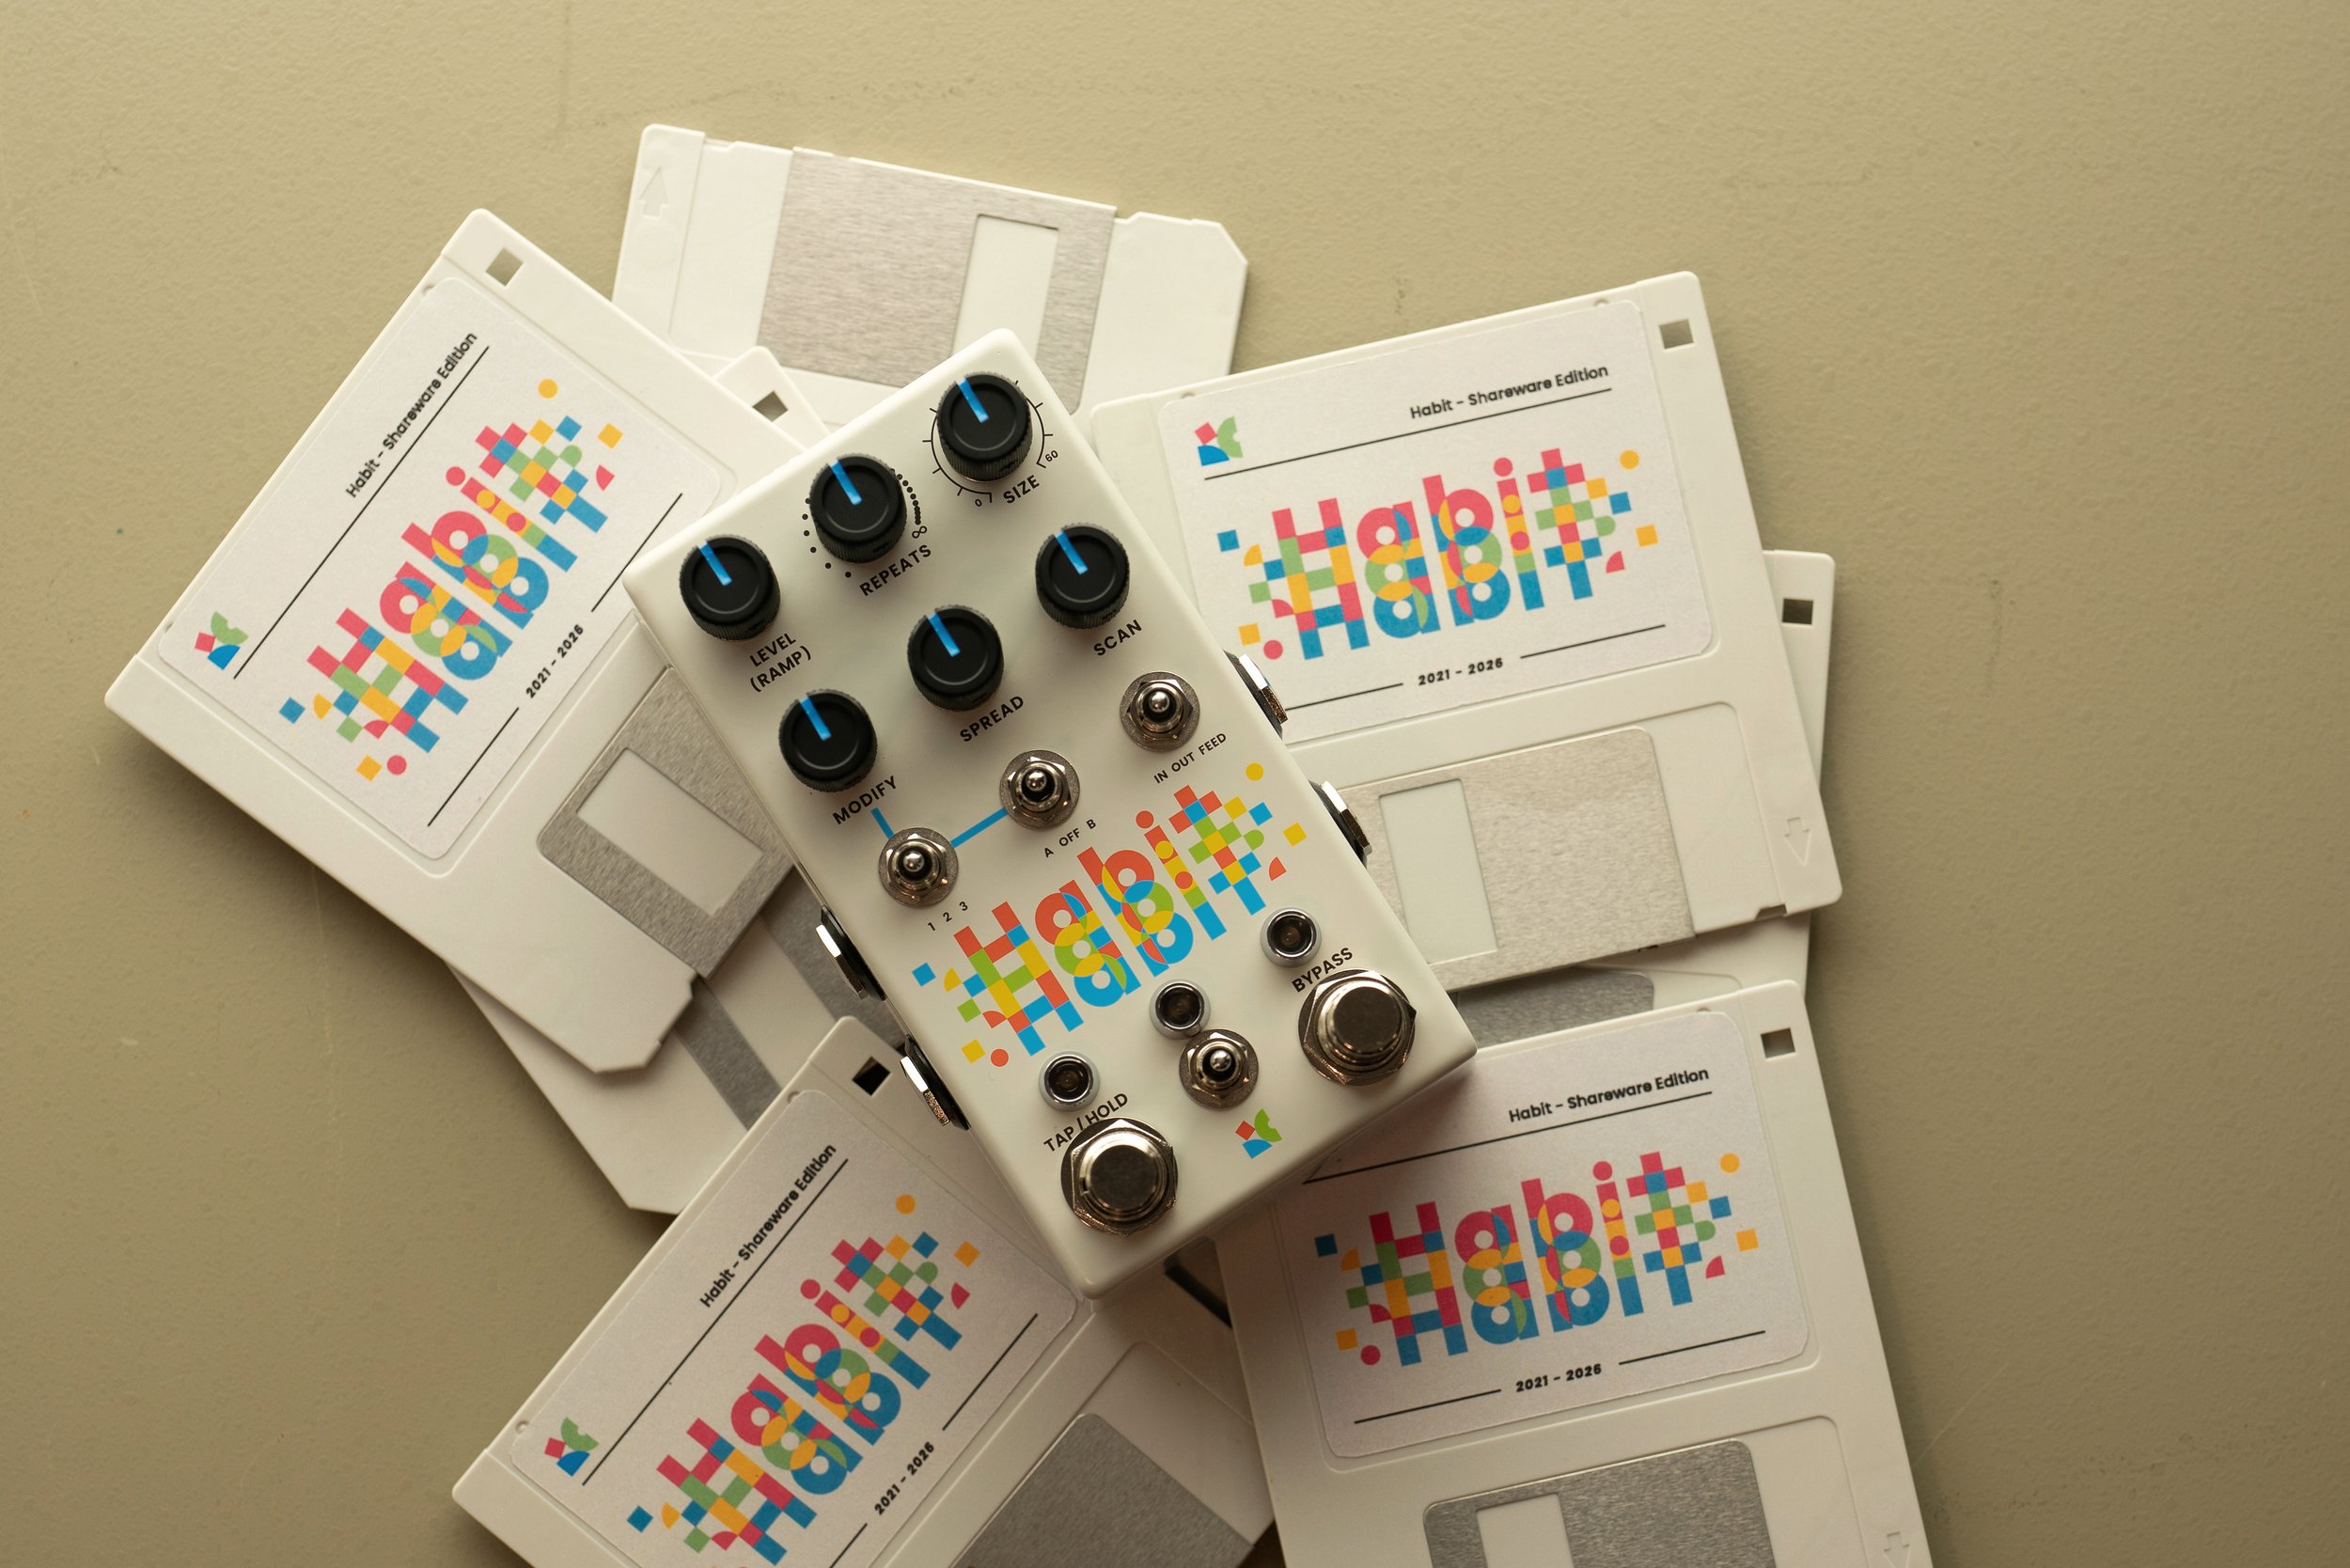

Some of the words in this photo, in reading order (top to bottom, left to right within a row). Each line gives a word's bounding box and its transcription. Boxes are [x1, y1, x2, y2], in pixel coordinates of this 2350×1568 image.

[345, 459, 381, 498] Habit
[383, 379, 442, 450] Shareware
[436, 333, 478, 380] Edition
[1410, 399, 1453, 419] Habit
[1467, 379, 1553, 406] Shareware
[1555, 364, 1608, 387] Edition
[1043, 449, 1059, 463] 60
[1002, 474, 1041, 504] SIZE
[858, 543, 932, 597] REPEATS
[1266, 447, 1602, 661] Habit
[306, 422, 608, 753] Habit
[525, 667, 551, 698] 2021
[556, 624, 584, 659] 2026
[749, 633, 797, 667] LEVEL
[1092, 619, 1143, 657] SCAN
[749, 645, 812, 693] (RAMP)
[1418, 669, 1450, 686] 2021
[1468, 657, 1504, 675] 2026
[959, 695, 1025, 743] SPREAD
[1153, 769, 1169, 784] IN
[1170, 751, 1195, 773] OUT
[1198, 732, 1228, 756] FEED
[832, 775, 897, 825] MODIFY
[1043, 846, 1055, 858] A
[1058, 827, 1080, 848] OFF
[1086, 819, 1097, 830] B
[927, 920, 936, 932] 1
[942, 911, 952, 923] 2
[959, 901, 969, 912] 3
[953, 785, 1266, 1057] Habit
[1291, 947, 1354, 993] BYPASS
[1509, 1101, 1553, 1123] Habit
[1567, 1082, 1653, 1109] Shareware
[1654, 1066, 1709, 1090] Edition
[1042, 1126, 1074, 1152] TAP
[1083, 1092, 1129, 1127] HOLD
[699, 1268, 735, 1308] Habit
[738, 1189, 800, 1261] Shareware
[793, 1144, 837, 1192] Edition
[1361, 1151, 1702, 1367] Habit
[656, 1236, 963, 1567] Habit
[1515, 1374, 1548, 1393] 2021
[1565, 1363, 1602, 1382] 2026
[874, 1483, 901, 1515] 2021
[906, 1441, 934, 1476] 2026
